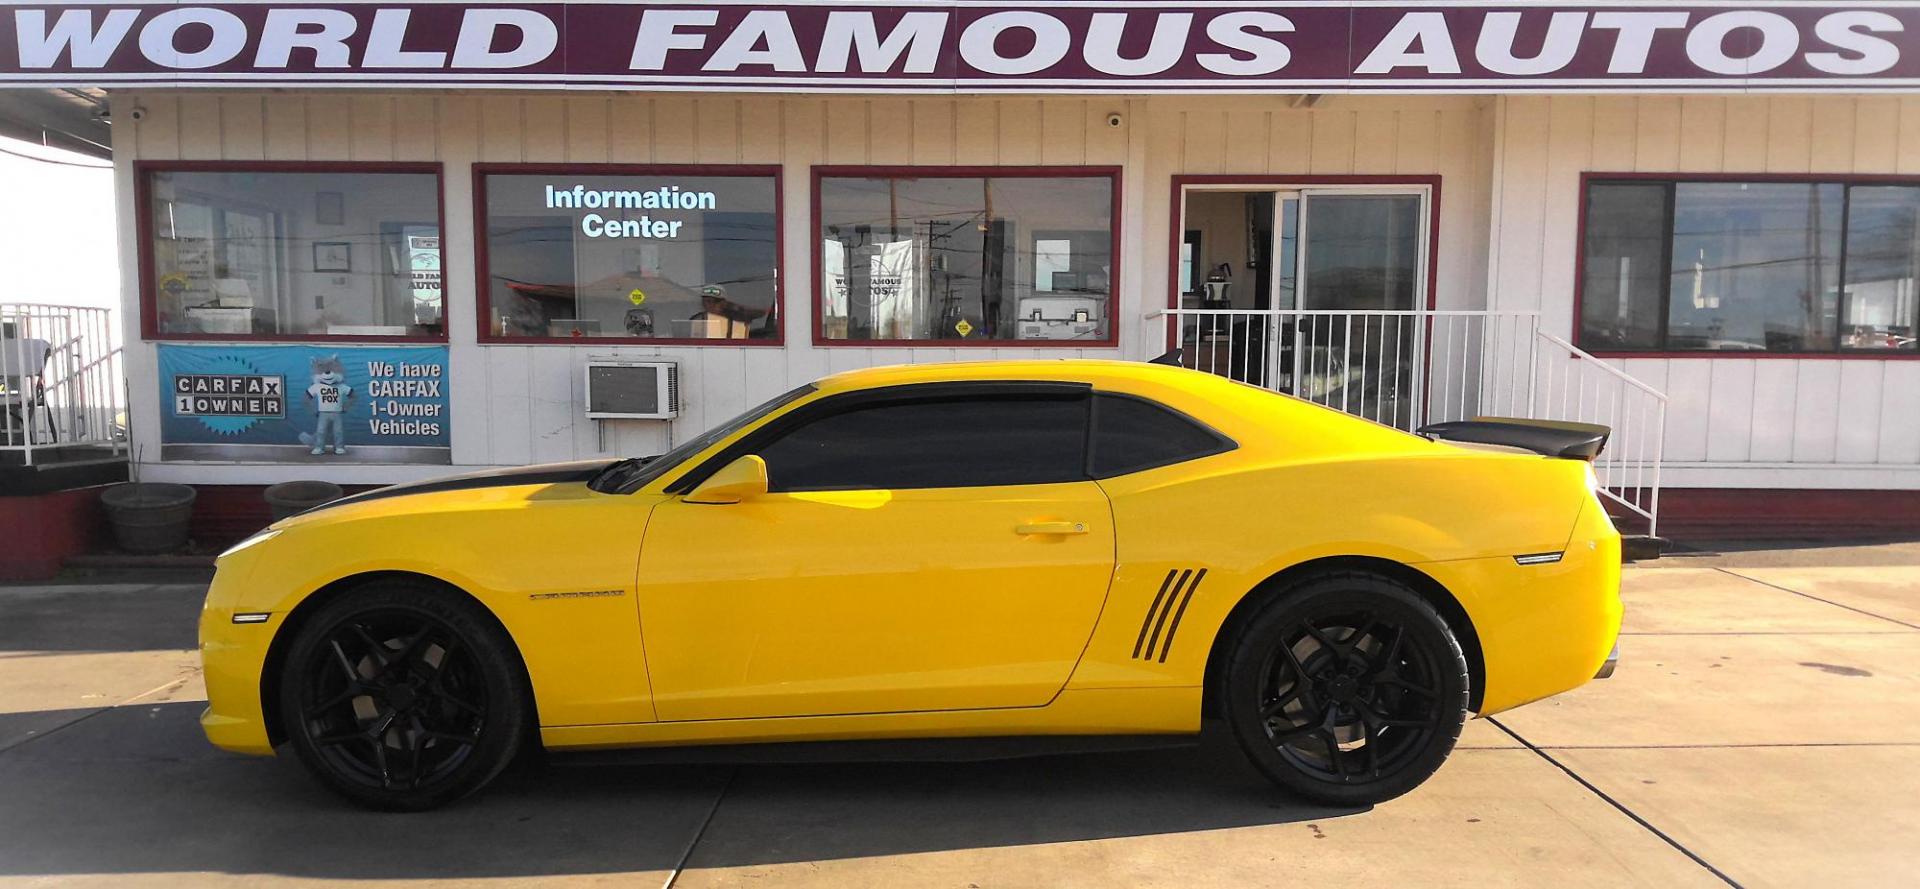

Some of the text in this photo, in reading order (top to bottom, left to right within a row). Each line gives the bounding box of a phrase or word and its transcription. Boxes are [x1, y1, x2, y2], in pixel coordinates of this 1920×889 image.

[15, 7, 1905, 76] WORLD FAMOUS AUTOS
[545, 184, 716, 210] Information
[581, 213, 683, 238] Center
[408, 281, 440, 290] AUTO
[367, 361, 442, 377] We have
[178, 378, 279, 395] CARFAX
[320, 387, 339, 395] CAR
[368, 379, 441, 398] CARFAX
[180, 398, 279, 413] 1 OWNER
[321, 395, 339, 404] FOX
[369, 400, 442, 416] 1-Owner
[369, 419, 441, 436] Vehicles
